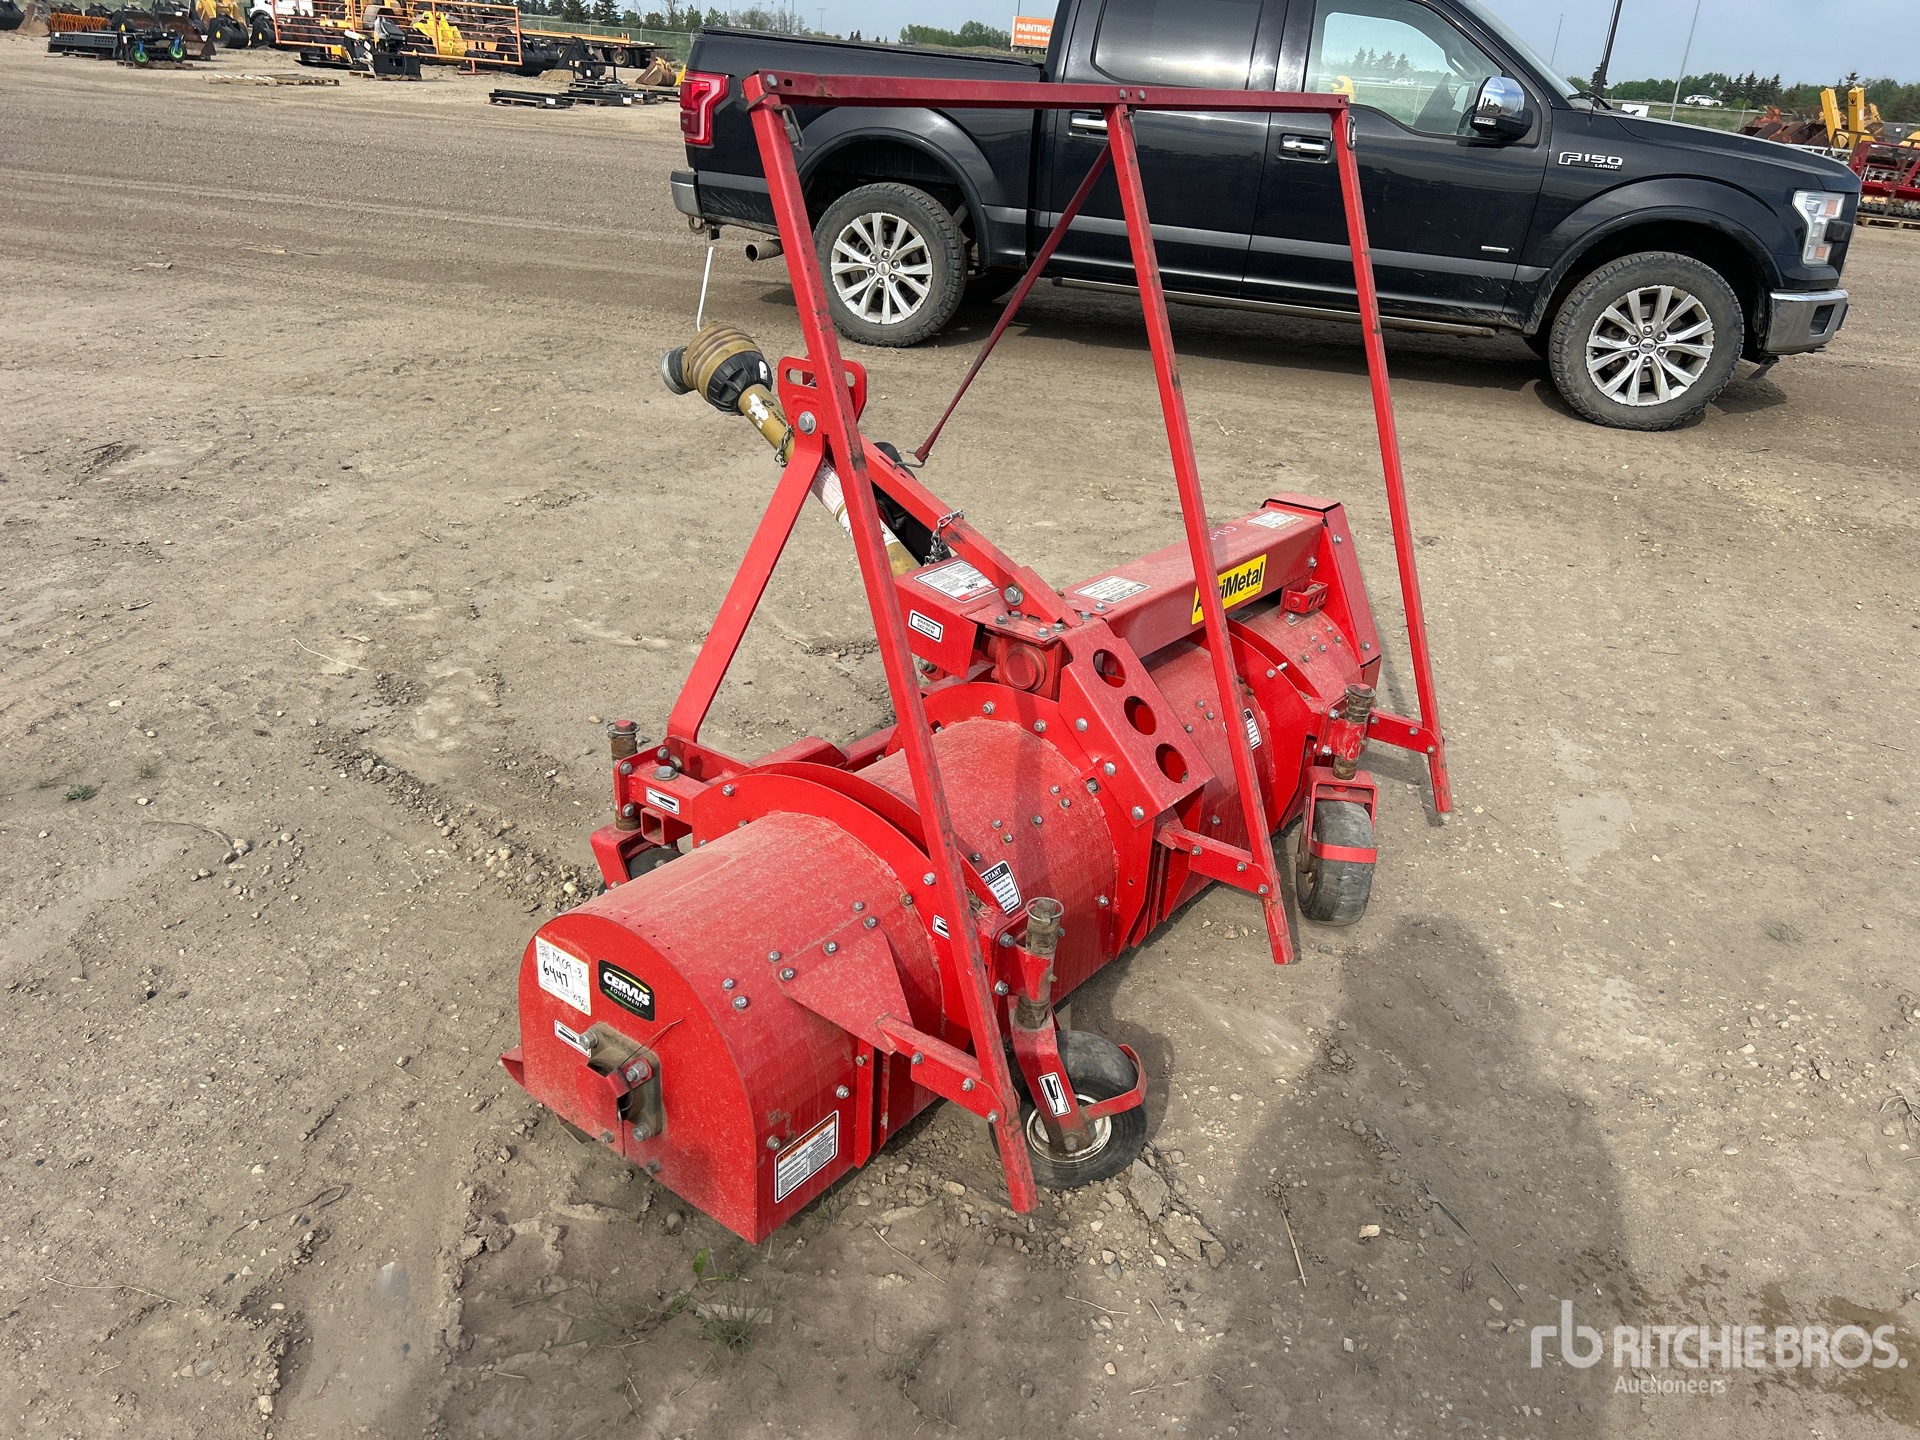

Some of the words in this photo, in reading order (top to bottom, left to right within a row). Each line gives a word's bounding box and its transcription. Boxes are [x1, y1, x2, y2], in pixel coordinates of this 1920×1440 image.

[1016, 23, 1051, 34] PAINTING
[603, 971, 651, 1006] CERVUS
[610, 986, 643, 1008] EQUIPMENT
